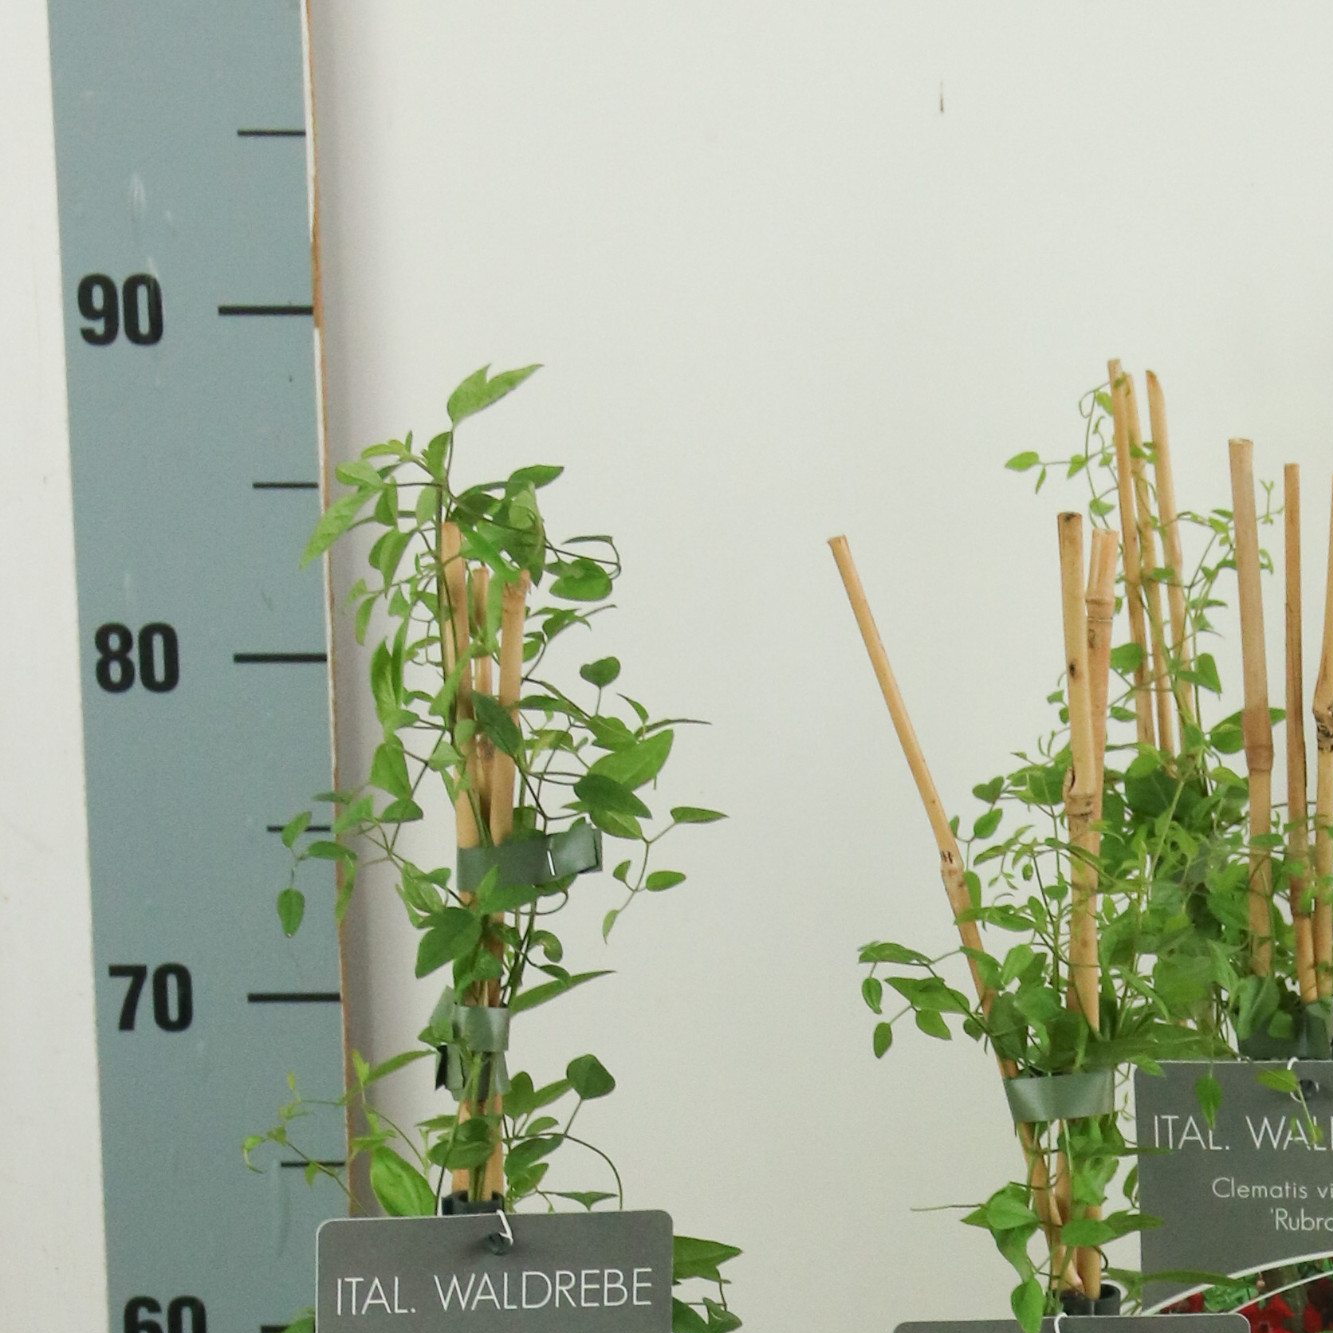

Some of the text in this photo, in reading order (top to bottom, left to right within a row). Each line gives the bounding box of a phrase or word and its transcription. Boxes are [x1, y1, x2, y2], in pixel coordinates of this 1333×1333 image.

[76, 273, 164, 346] 90
[95, 622, 179, 694] 80
[108, 963, 193, 1034] 70
[1154, 1115, 1230, 1150] ITAL.
[1212, 1177, 1308, 1199] Clematis
[337, 1268, 652, 1315] ITAL. WALDREBE
